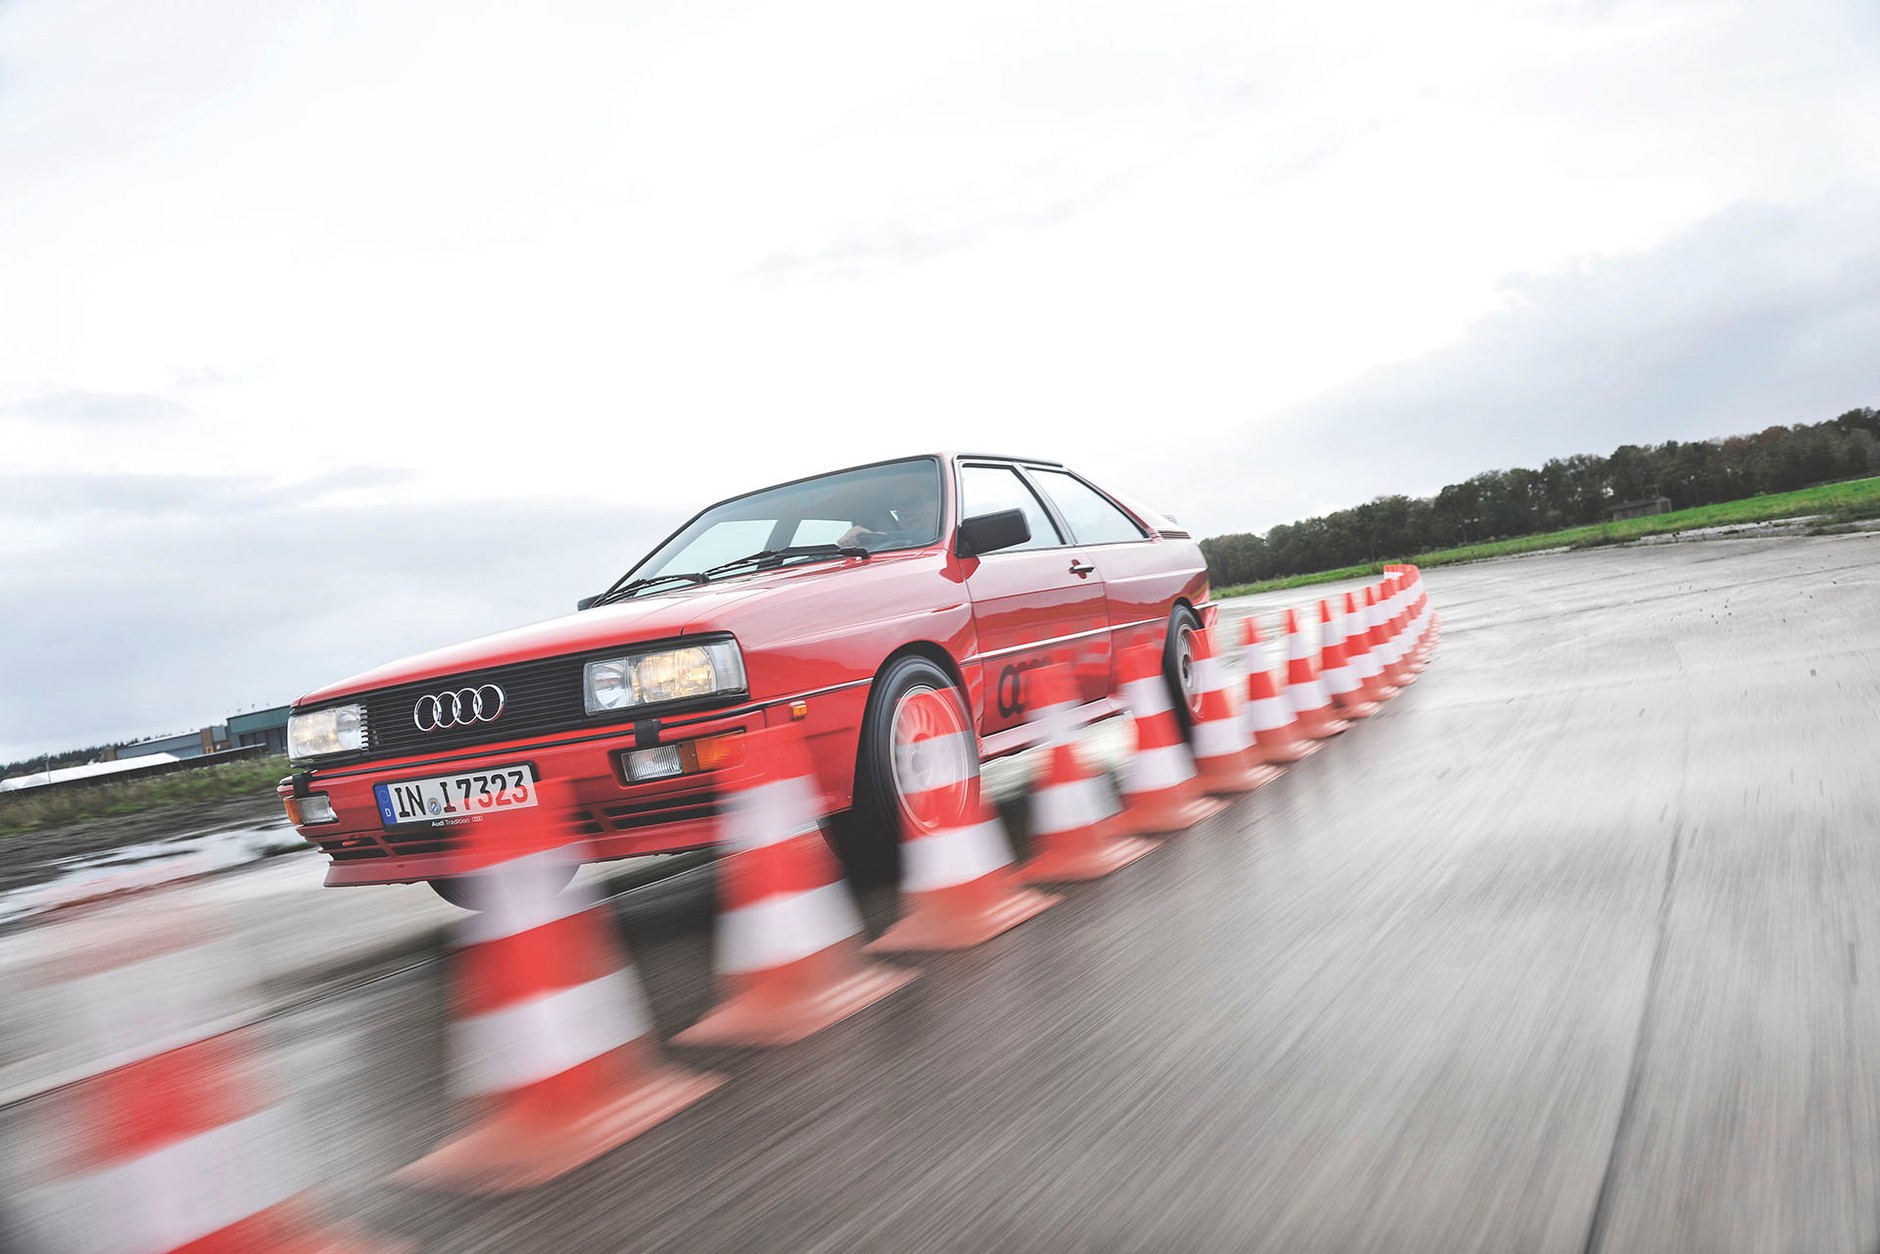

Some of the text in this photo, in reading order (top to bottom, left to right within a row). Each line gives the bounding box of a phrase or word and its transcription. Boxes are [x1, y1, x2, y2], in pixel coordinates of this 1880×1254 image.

[394, 785, 426, 818] IN
[384, 808, 392, 817] D
[431, 817, 470, 828] Audi Tradition
